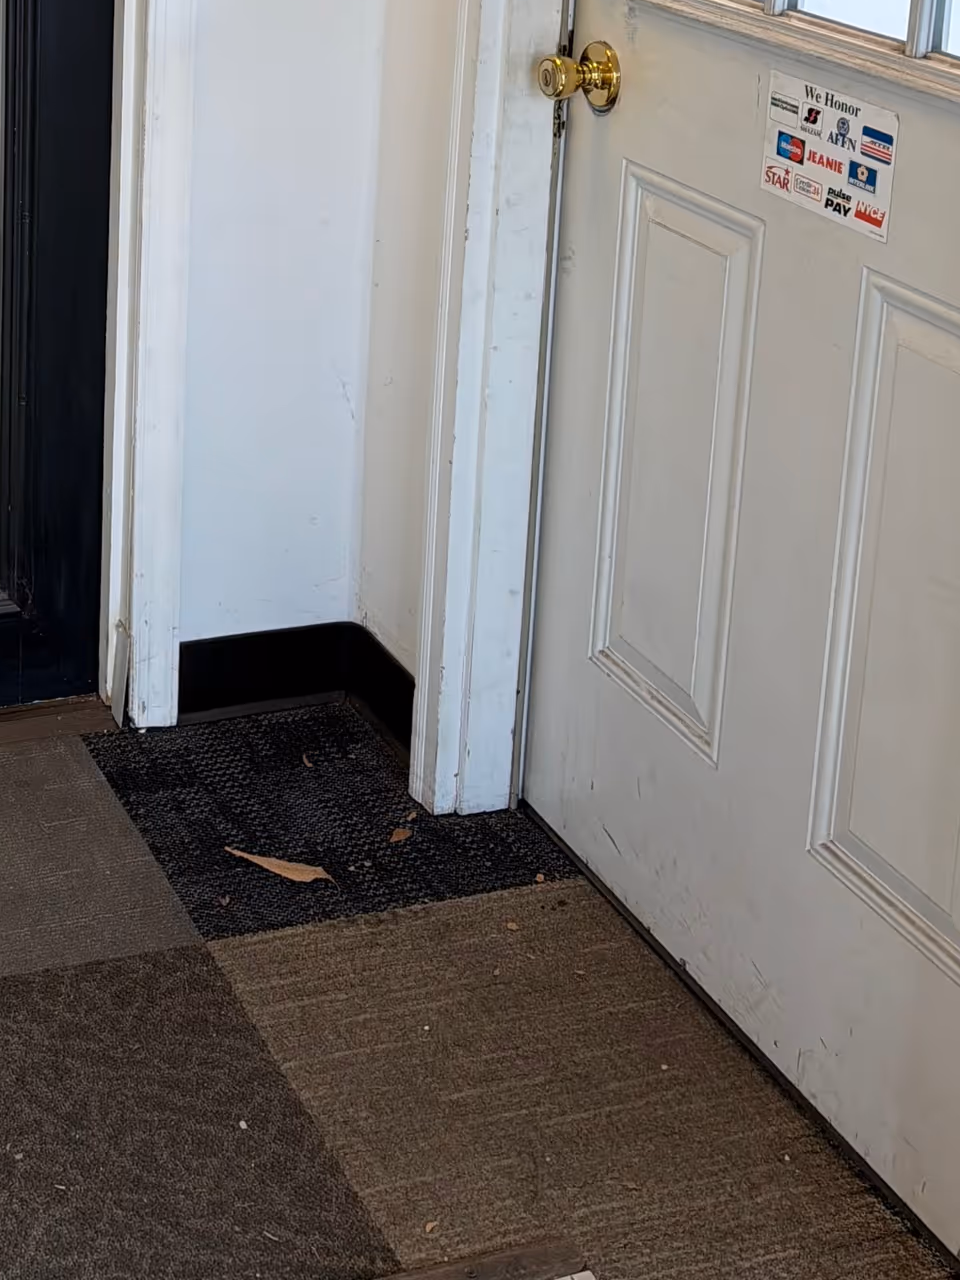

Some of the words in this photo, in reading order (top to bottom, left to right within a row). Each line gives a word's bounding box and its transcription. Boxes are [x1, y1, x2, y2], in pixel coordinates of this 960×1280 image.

[805, 84, 821, 103] We
[824, 91, 861, 117] Honor
[826, 130, 857, 152] AFFN
[806, 148, 843, 174] JEANIE
[765, 169, 789, 192] STAR
[827, 187, 852, 202] pulse
[824, 197, 851, 217] PAY
[856, 201, 886, 221] NYCE
